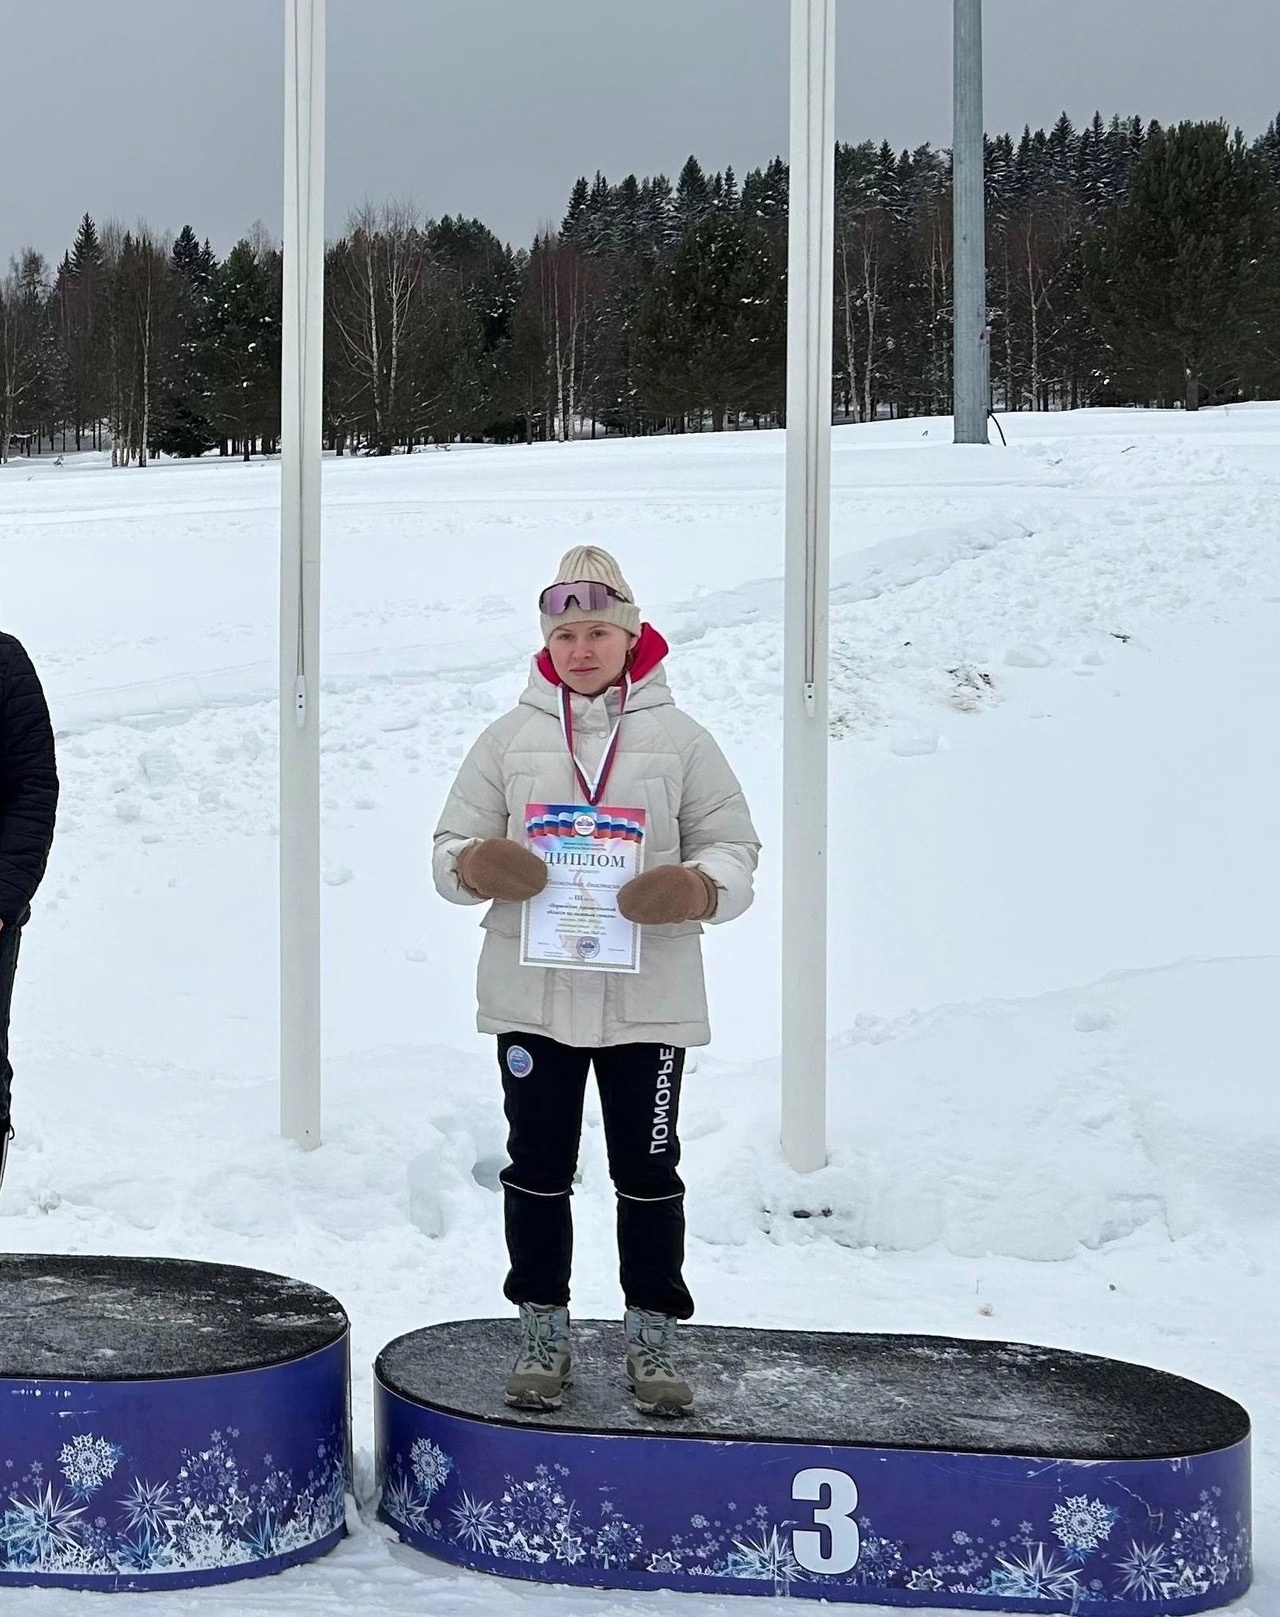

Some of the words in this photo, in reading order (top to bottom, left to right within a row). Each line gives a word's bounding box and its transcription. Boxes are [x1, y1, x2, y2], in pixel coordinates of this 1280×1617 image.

[544, 852, 626, 868] ДИПЛОМ
[649, 1047, 675, 1154] ПОМОРЬЕ
[791, 1467, 860, 1574] 3
